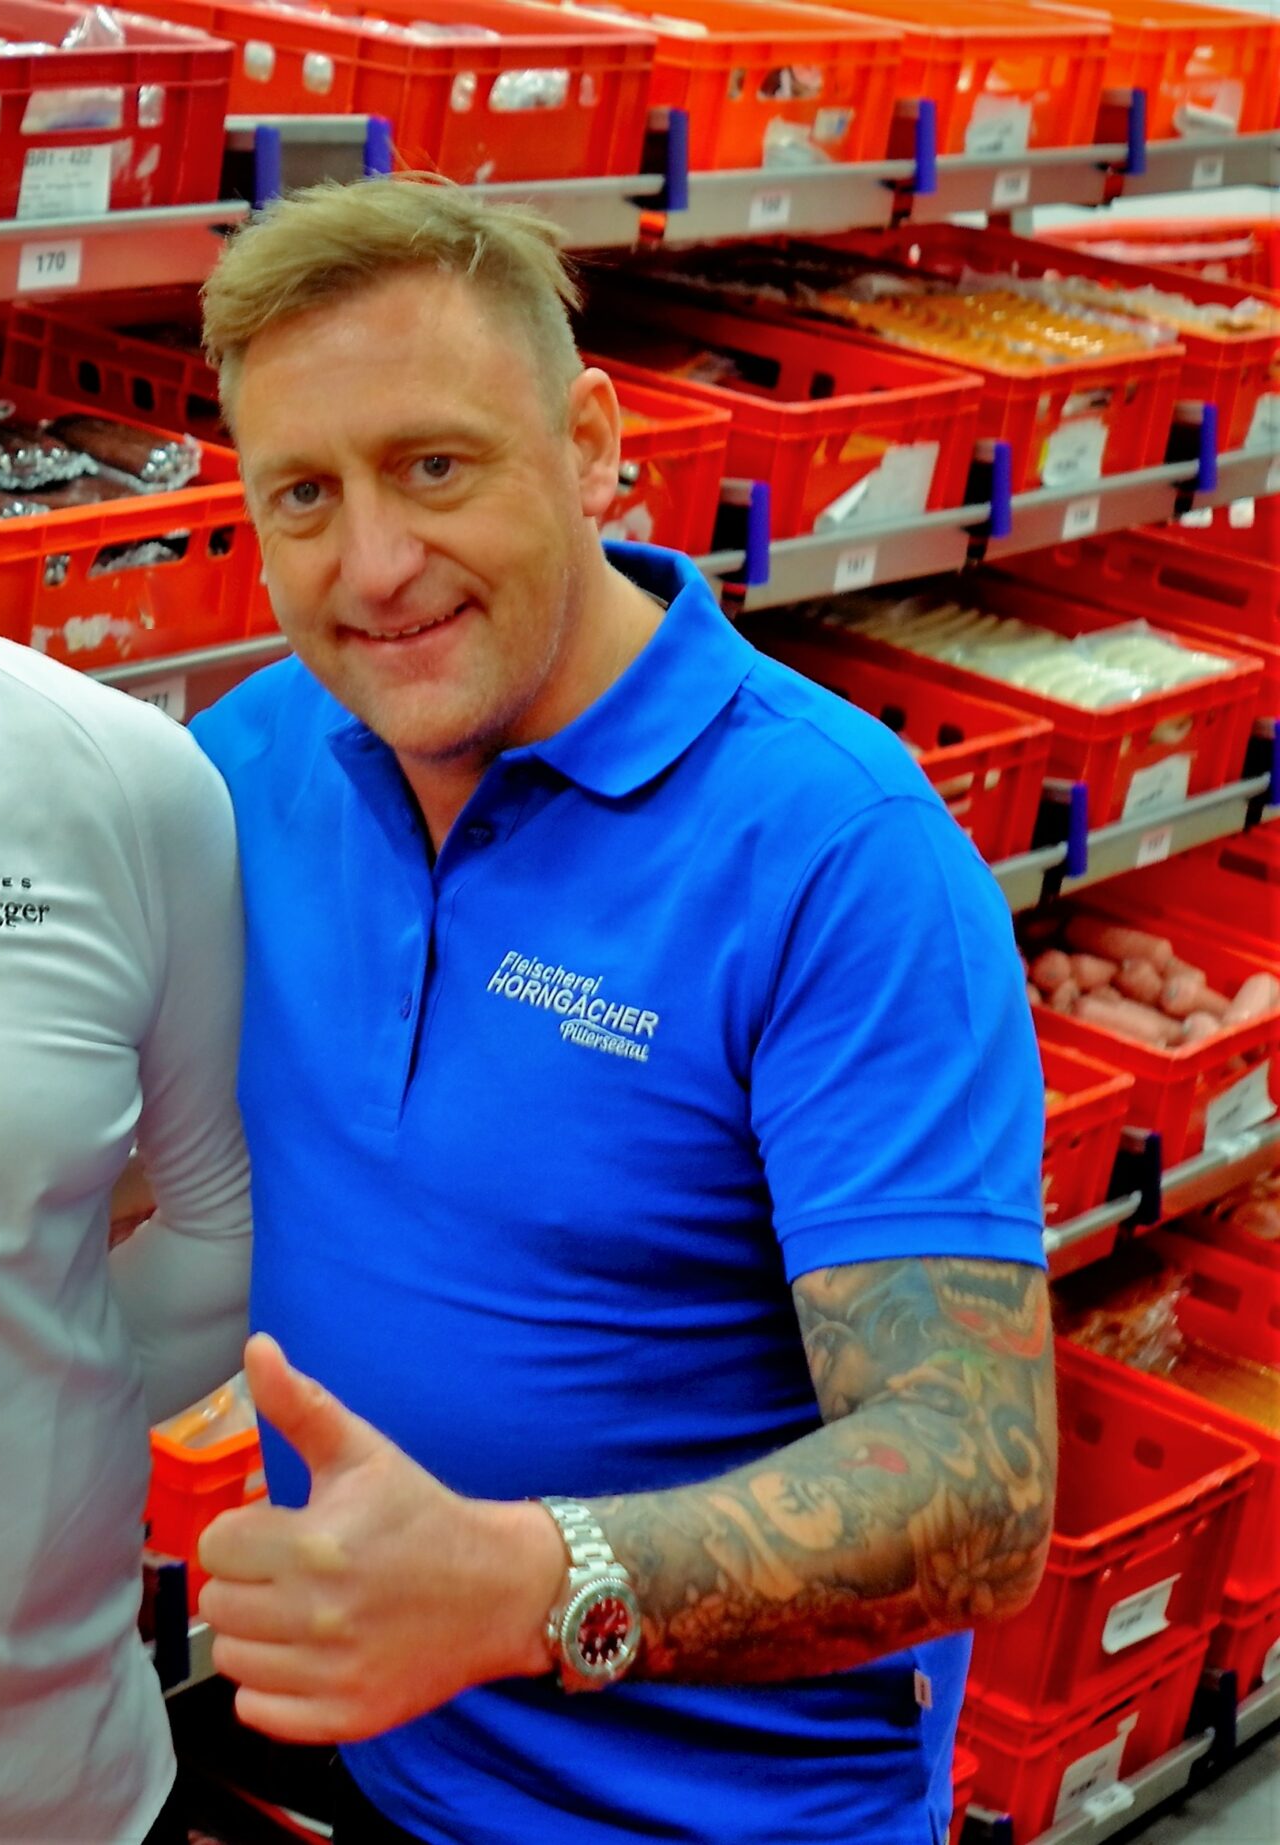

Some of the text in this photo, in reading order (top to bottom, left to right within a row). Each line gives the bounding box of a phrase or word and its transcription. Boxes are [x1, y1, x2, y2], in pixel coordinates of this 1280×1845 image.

[36, 250, 67, 273] 170
[499, 950, 604, 997] Fleischerei
[486, 968, 660, 1040] HORNGACHER
